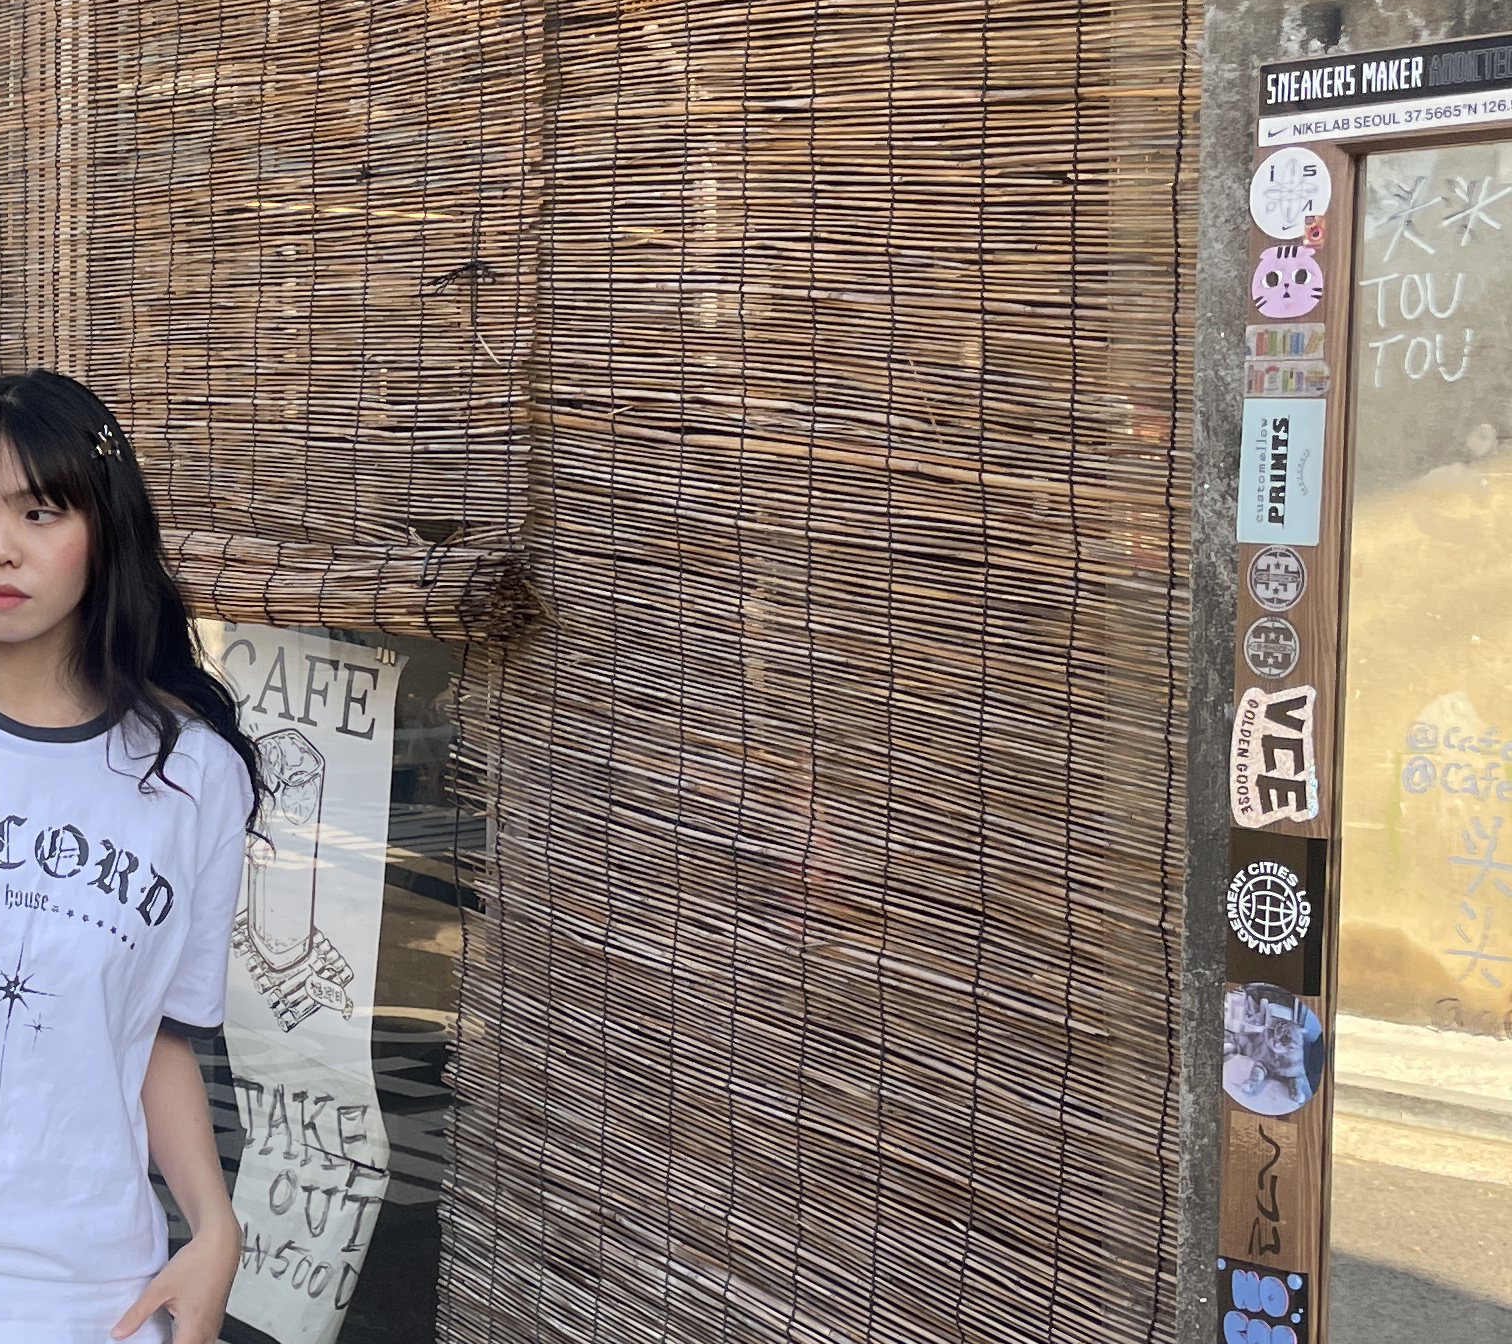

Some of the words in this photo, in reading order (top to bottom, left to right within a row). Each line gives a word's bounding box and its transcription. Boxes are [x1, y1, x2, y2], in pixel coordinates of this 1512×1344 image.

[1266, 64, 1356, 105] SNEAKERS
[1362, 56, 1424, 94] MAKER
[1292, 118, 1350, 136] NIKELAB
[1354, 114, 1401, 130] SEOUL
[1359, 272, 1466, 329] TOU
[1368, 327, 1475, 388] TOU
[1256, 417, 1269, 523] customellow
[1268, 417, 1289, 524] PRINTS
[222, 638, 380, 741] CAFE
[1236, 698, 1259, 759] GOLDEN
[1236, 763, 1254, 815] GOOSE
[3, 883, 51, 912] house
[1247, 861, 1299, 887] CITIES
[1226, 869, 1299, 955] MANAGEMENT
[1295, 890, 1311, 939] LOST
[233, 1076, 389, 1188] TAKE
[269, 1167, 384, 1253] OUT
